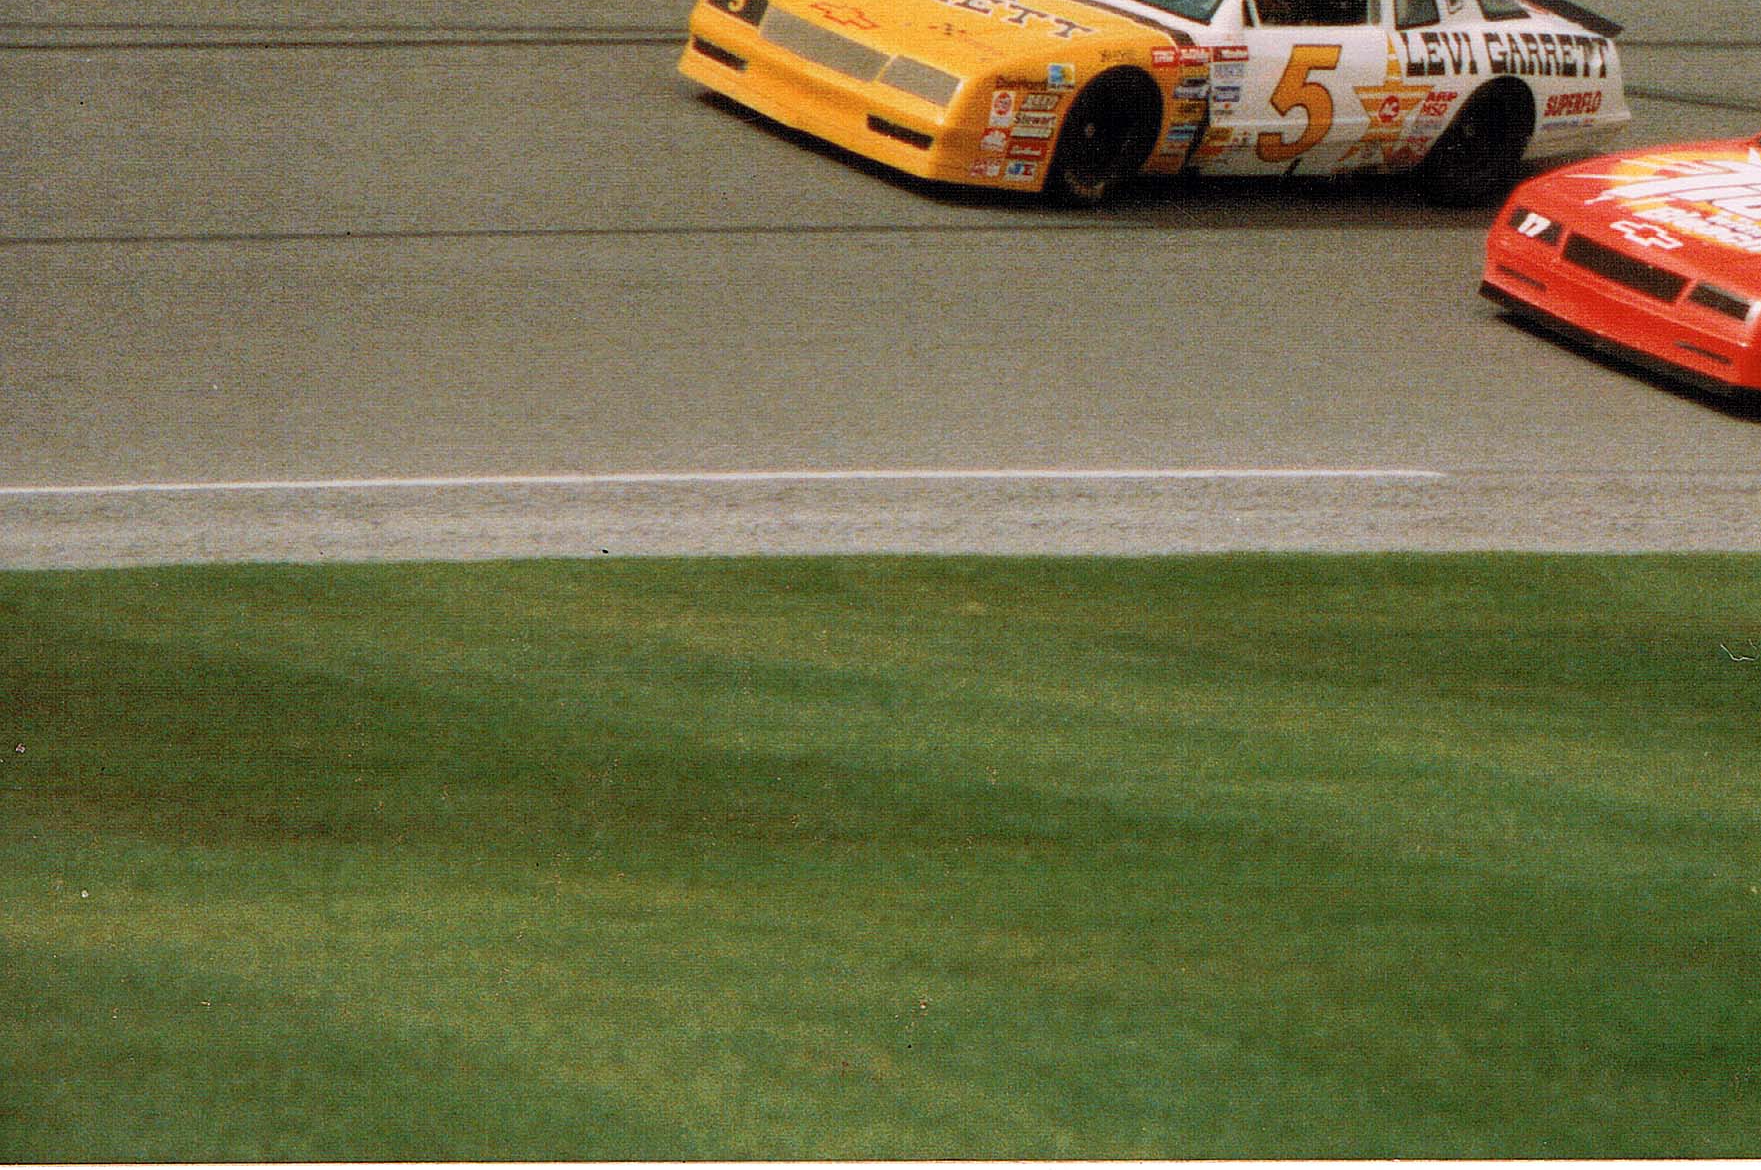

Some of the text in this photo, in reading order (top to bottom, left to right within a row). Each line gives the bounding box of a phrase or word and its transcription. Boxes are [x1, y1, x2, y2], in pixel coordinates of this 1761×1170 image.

[1400, 30, 1610, 80] LEVI GARRETT
[1255, 43, 1343, 163] 5
[1543, 90, 1602, 118] SUPERFLO
[1517, 212, 1552, 238] 17
